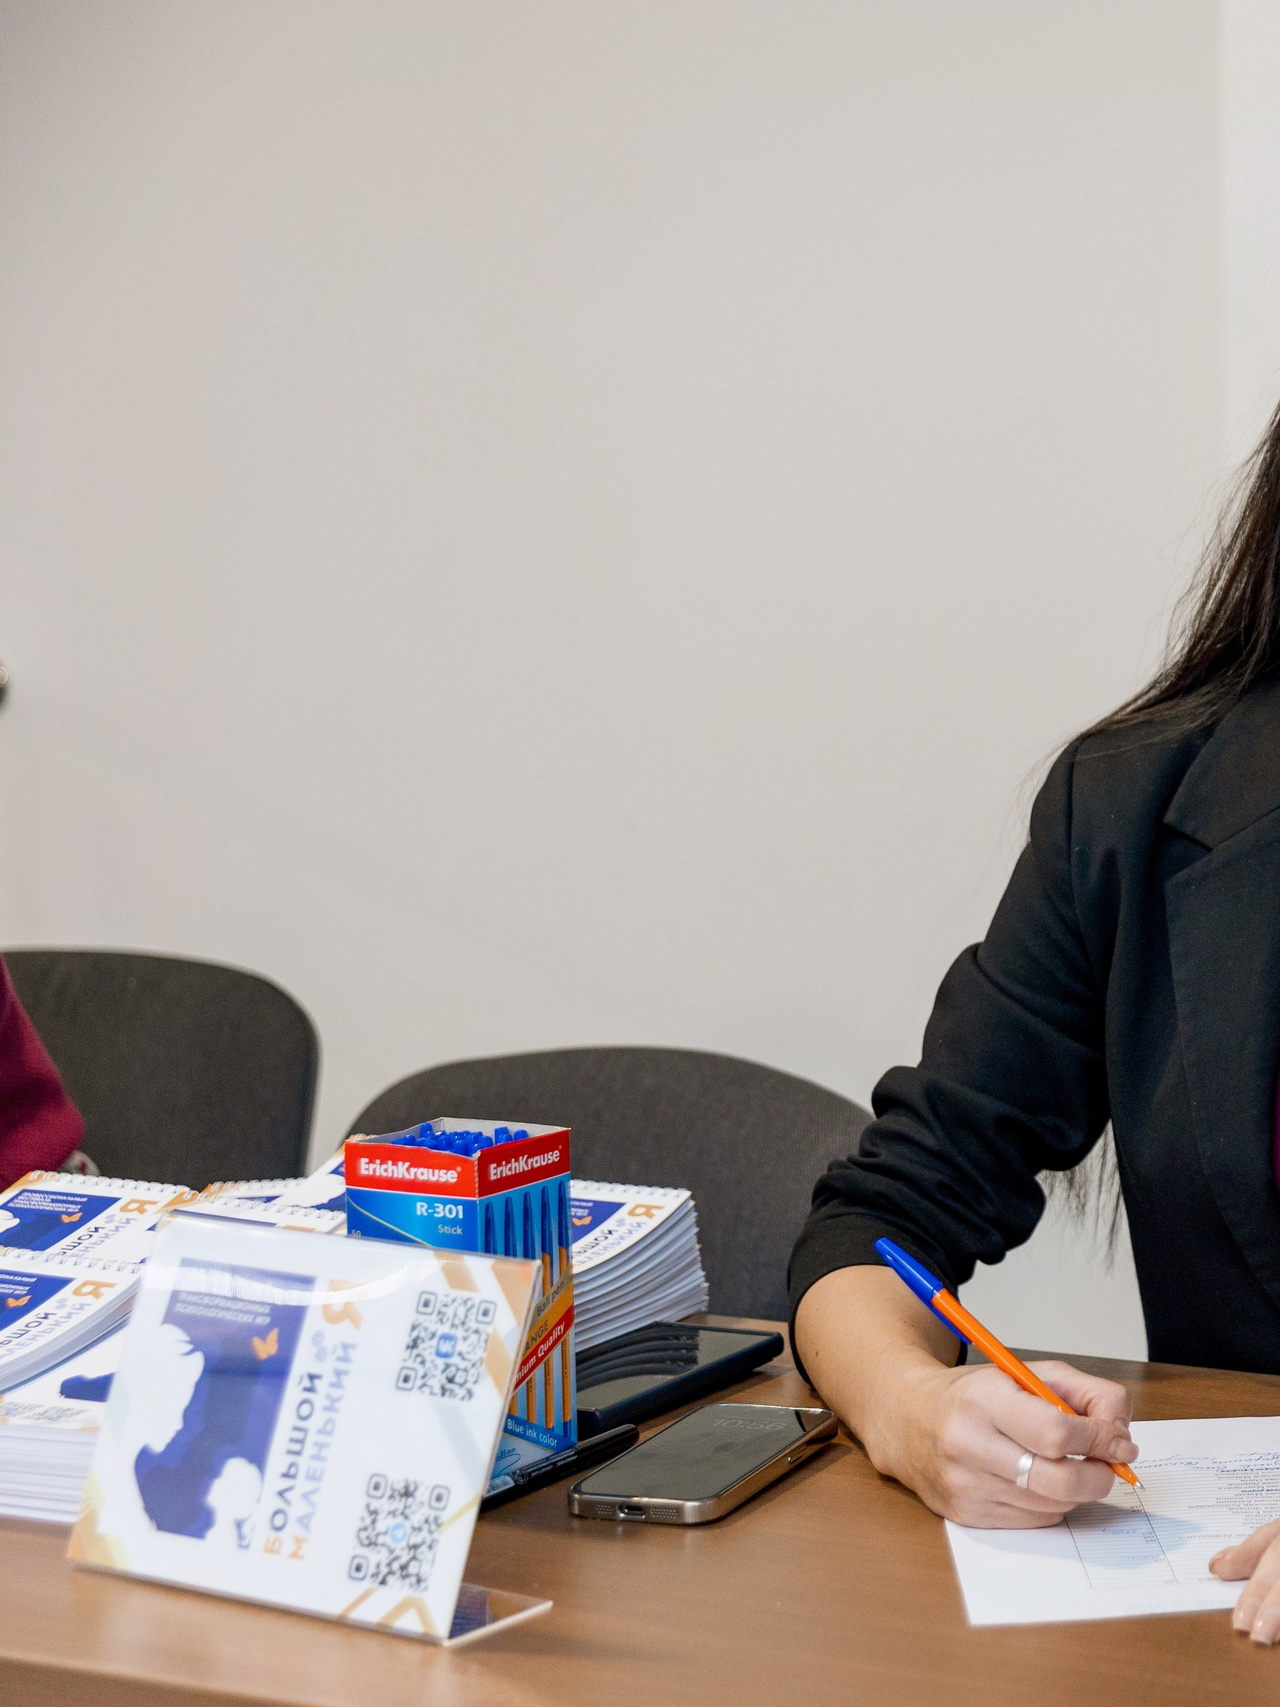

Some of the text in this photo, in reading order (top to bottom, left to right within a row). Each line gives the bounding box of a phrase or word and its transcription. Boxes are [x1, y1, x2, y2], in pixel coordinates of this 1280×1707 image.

[359, 1157, 459, 1184] ErichKrause
[489, 1148, 561, 1181] ErichKrause
[415, 1201, 465, 1219] R-301
[437, 1223, 463, 1235] Stick
[537, 1280, 565, 1317] Ball pen
[524, 1319, 549, 1352] ANGE
[537, 1321, 566, 1358] Quality
[507, 1418, 558, 1446] Blue ink color
[263, 1370, 325, 1556] БОЛЬШОЙ
[287, 1340, 359, 1562] МАЛЕНЬКИЙ
